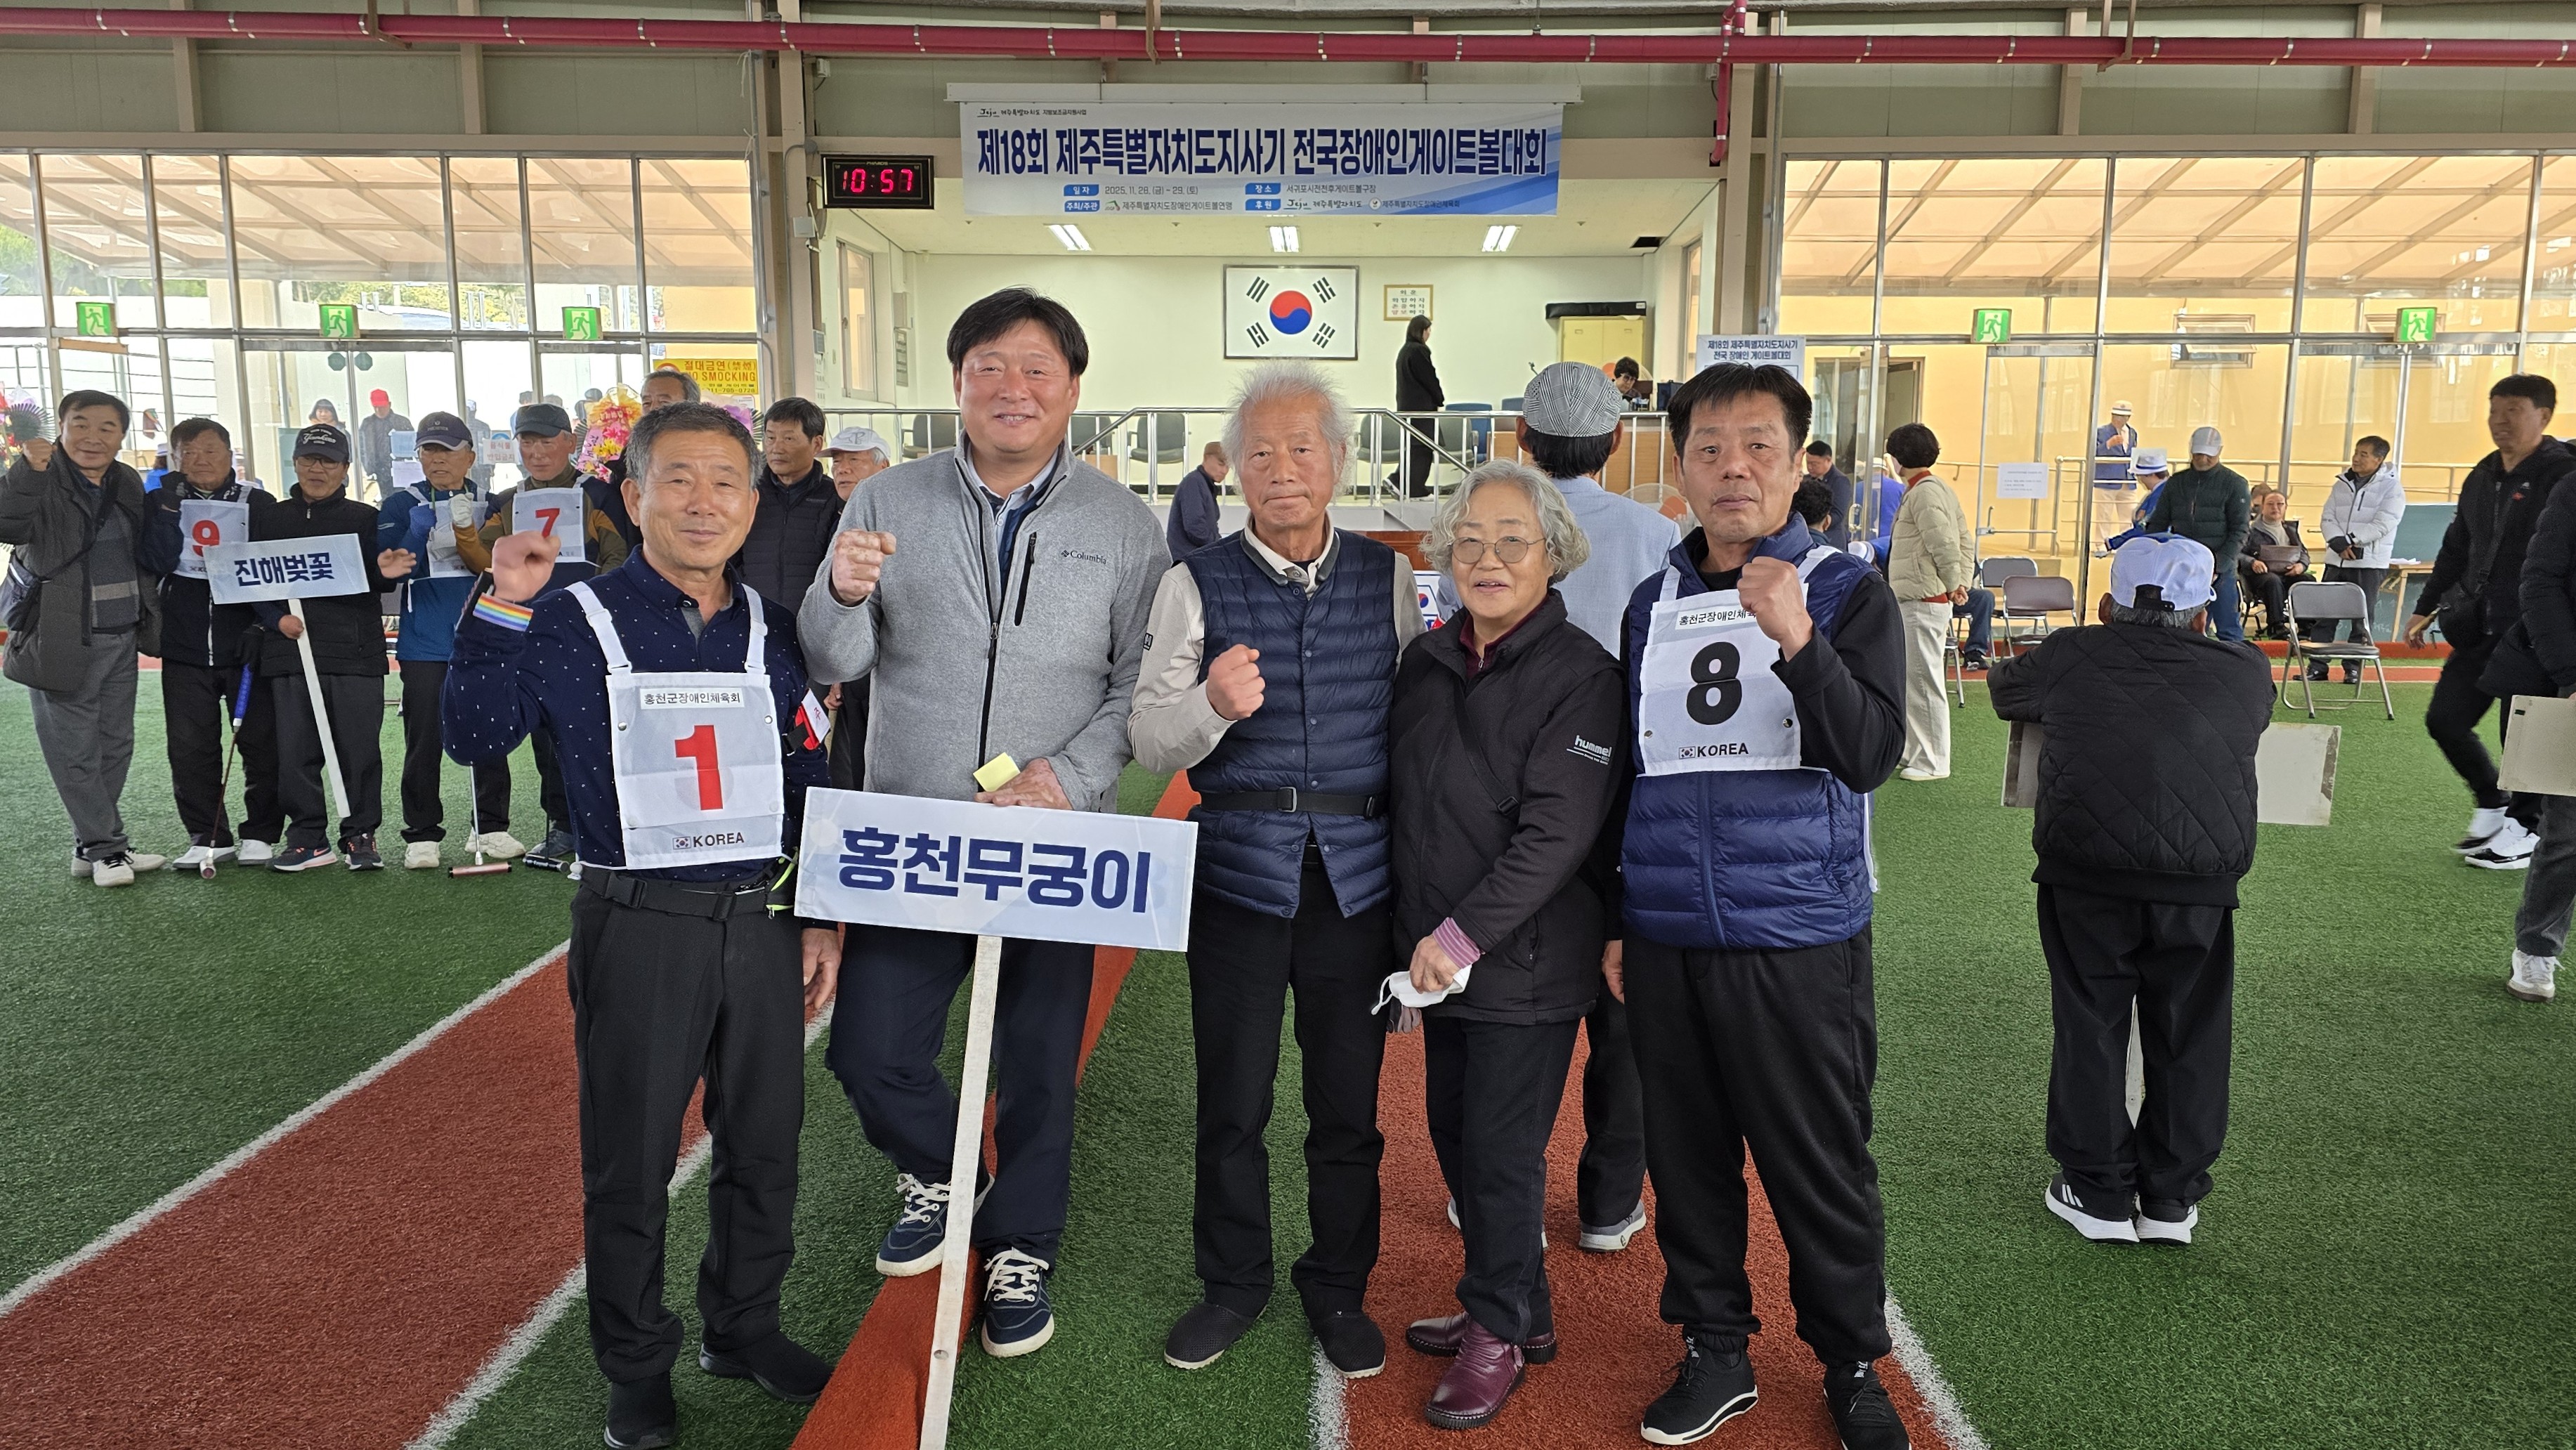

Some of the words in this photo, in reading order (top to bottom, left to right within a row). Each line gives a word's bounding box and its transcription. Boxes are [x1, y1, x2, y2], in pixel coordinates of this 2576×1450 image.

[977, 128, 1048, 175] 제18회
[1055, 128, 1286, 175] 제주특별자치도지사기
[1293, 128, 1547, 175] 전국장애인게이트볼대회
[842, 169, 914, 193] 10:57
[1708, 340, 1729, 349] 제18회
[1730, 340, 1798, 349] 제주특별자치도지사기
[1713, 351, 1727, 360] 전국
[702, 372, 756, 381] SMOCKING
[535, 508, 560, 538] 7
[192, 519, 220, 557] 9
[1070, 550, 1107, 565] Columbia
[235, 552, 335, 587] 진해벚꽃
[1687, 641, 1743, 725] 8
[644, 692, 740, 705] 홍천군장애인체육회
[1574, 735, 1612, 757] hummel
[1697, 743, 1749, 758] KOREA
[674, 724, 723, 811] 1
[693, 832, 745, 847] KOREA
[838, 826, 1151, 914] 홍천무궁이
